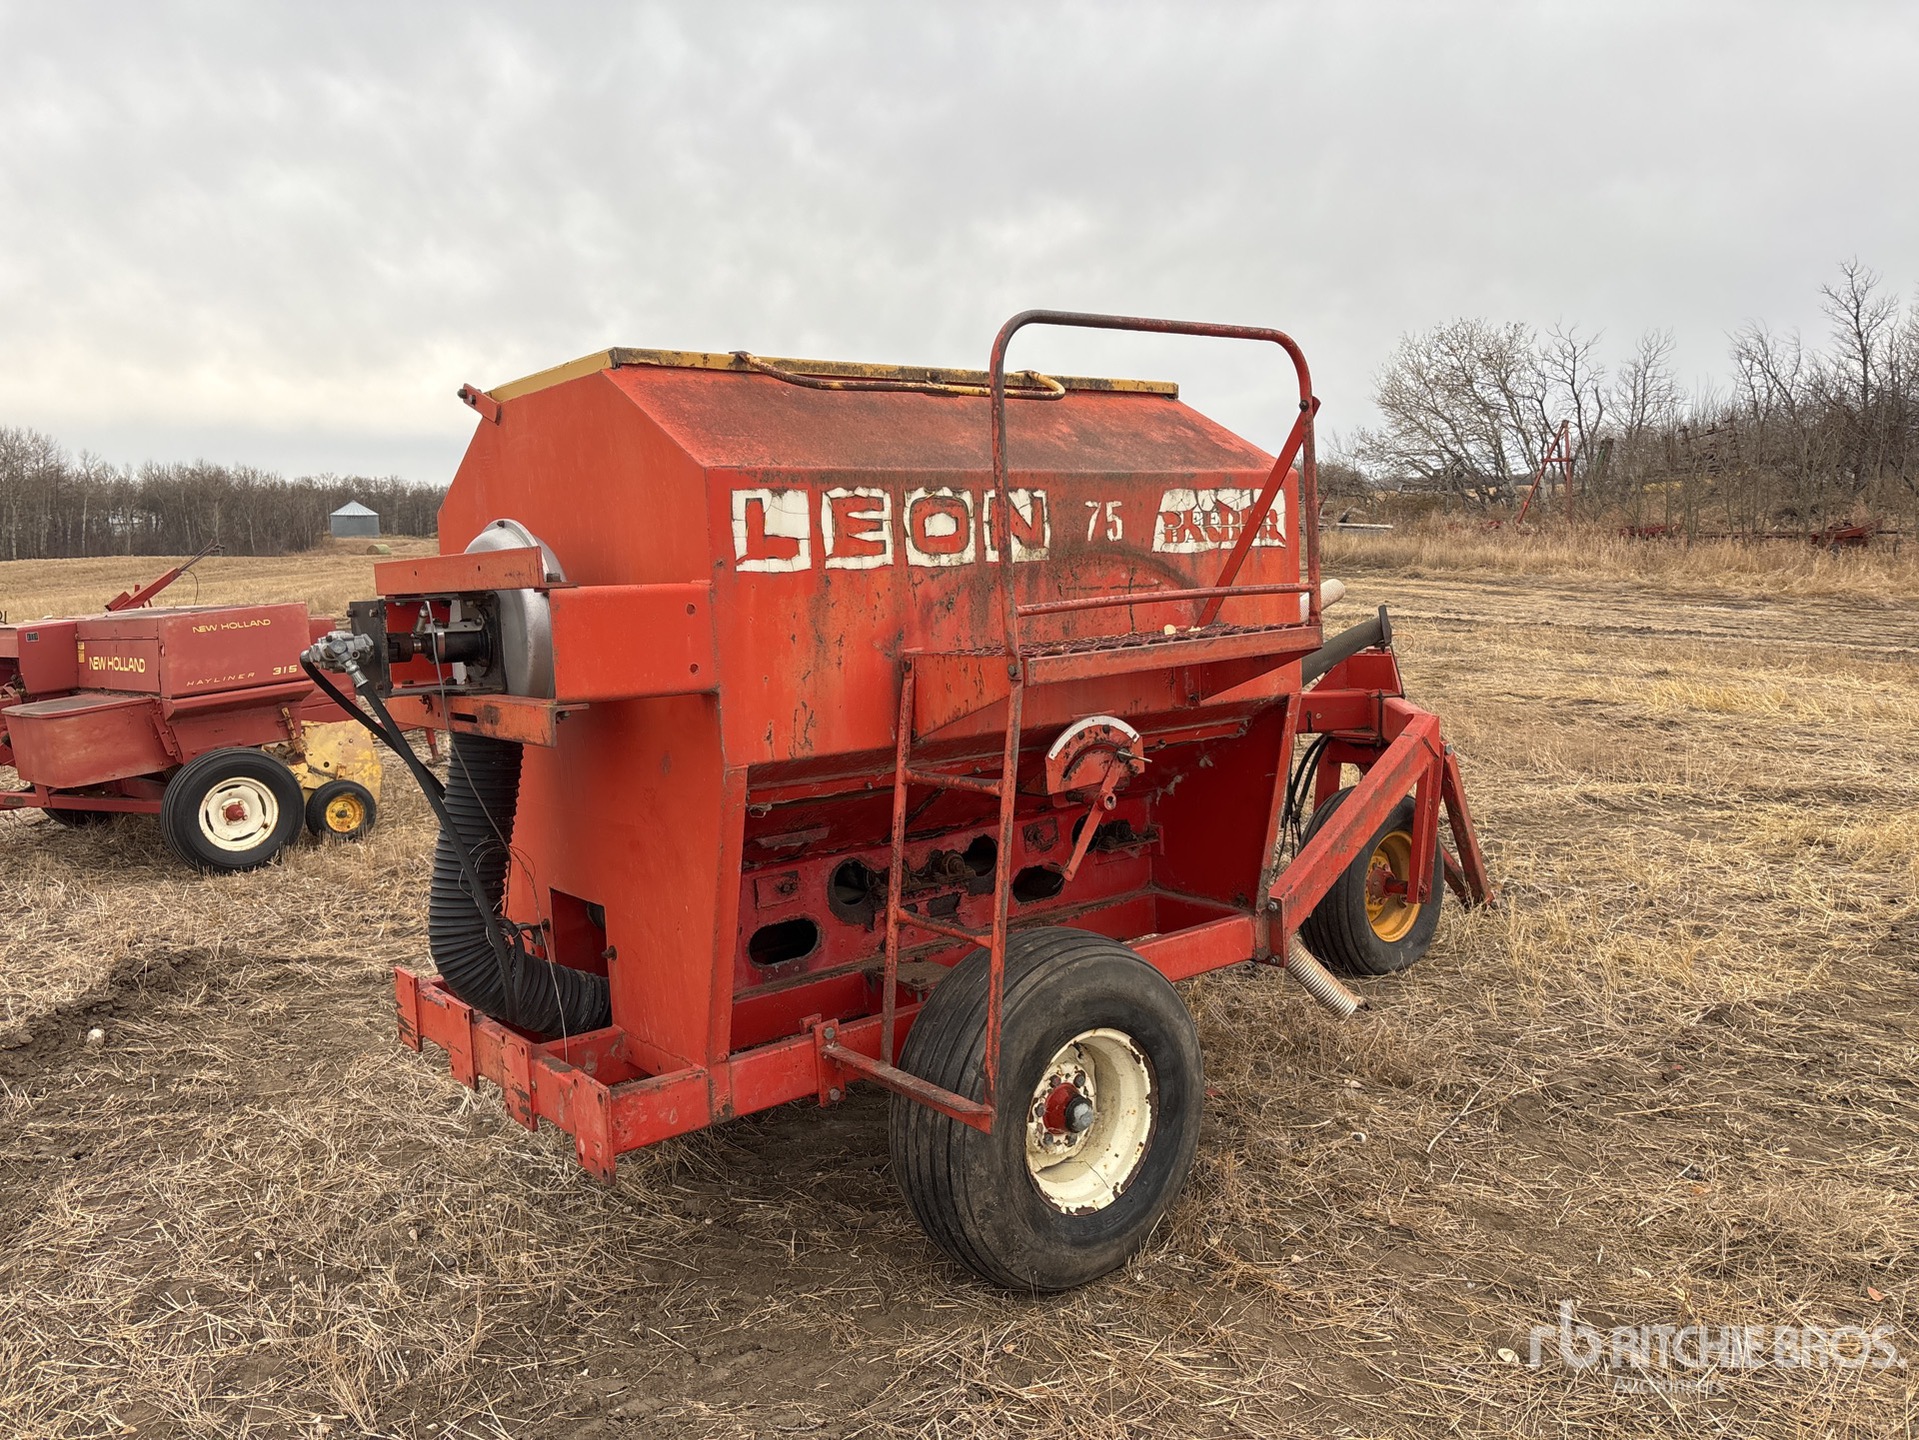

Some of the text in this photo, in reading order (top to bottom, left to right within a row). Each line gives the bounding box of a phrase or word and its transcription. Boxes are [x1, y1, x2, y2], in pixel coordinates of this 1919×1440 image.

[734, 488, 1123, 570] LEON 75
[191, 618, 272, 634] NEW HOLLAND
[88, 656, 146, 673] NEW HOLLAND
[186, 664, 298, 687] HAYLINER 315
